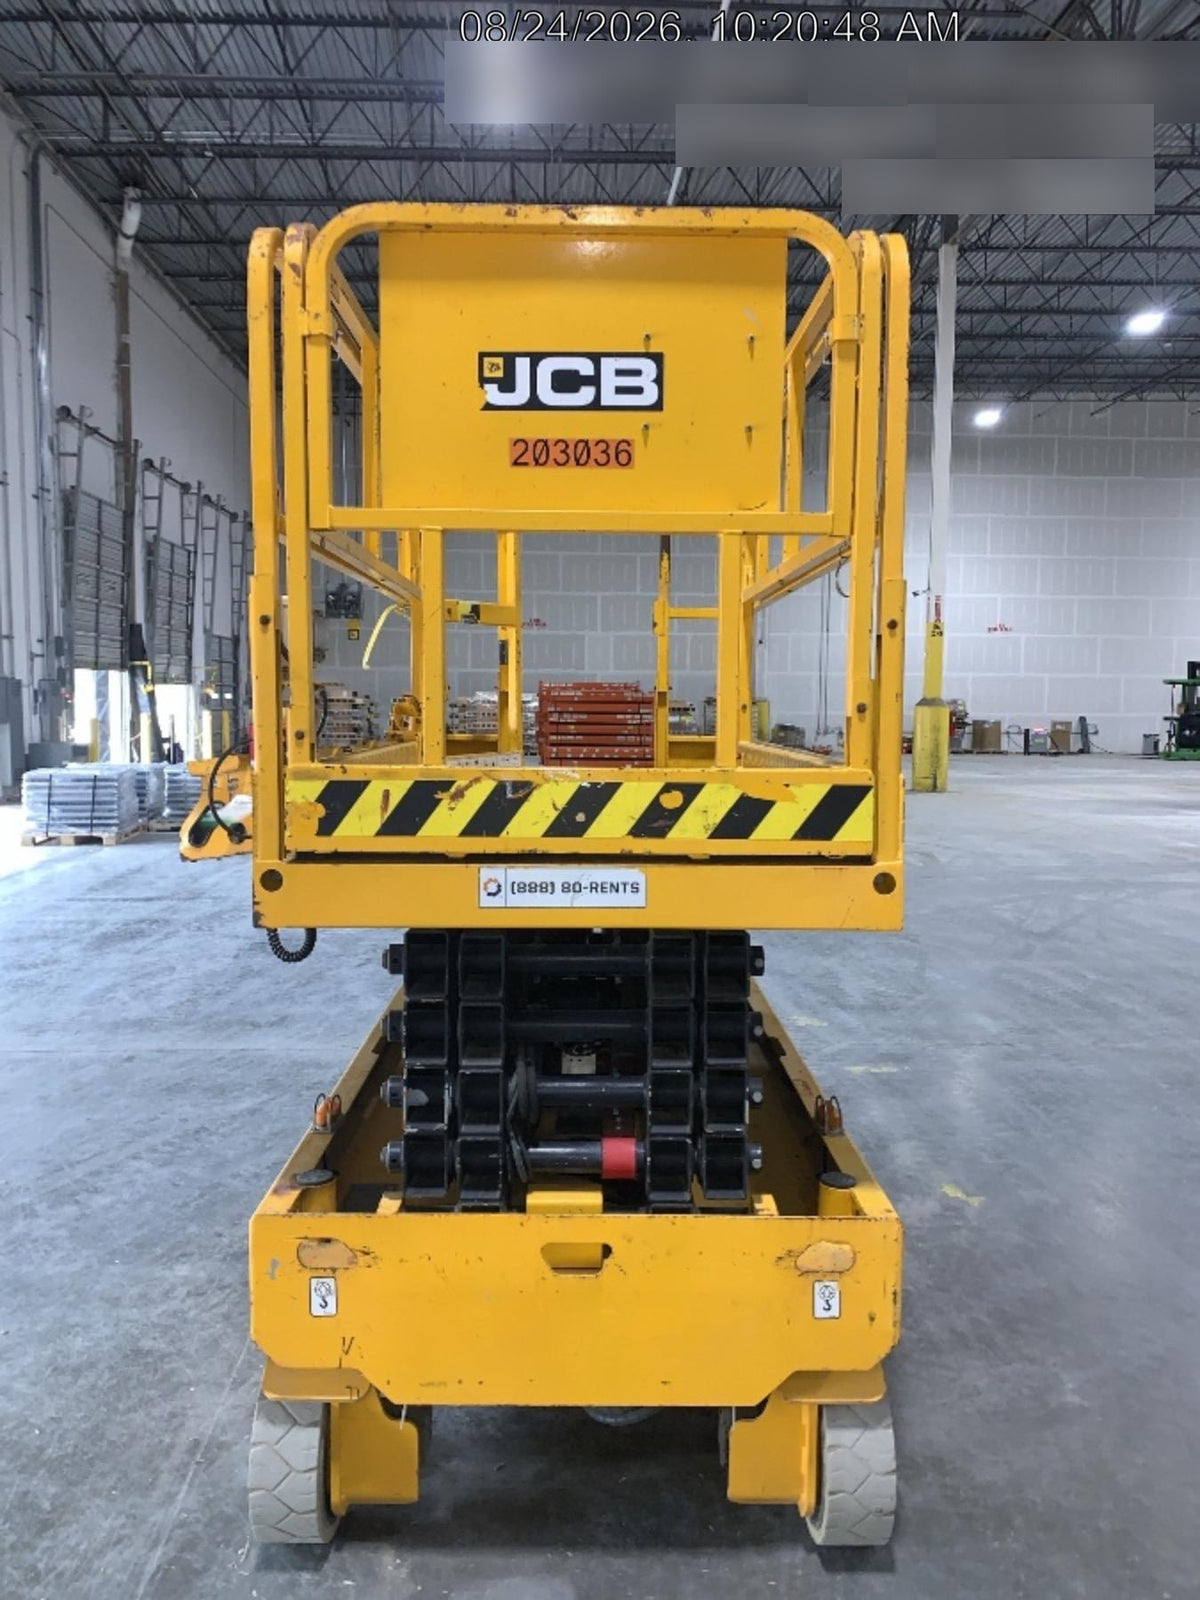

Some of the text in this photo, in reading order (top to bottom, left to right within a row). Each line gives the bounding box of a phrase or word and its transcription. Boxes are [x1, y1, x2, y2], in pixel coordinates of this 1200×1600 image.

[483, 356, 660, 407] JCB
[511, 437, 633, 468] 203036
[511, 880, 641, 896] (888) 80-RENTS
